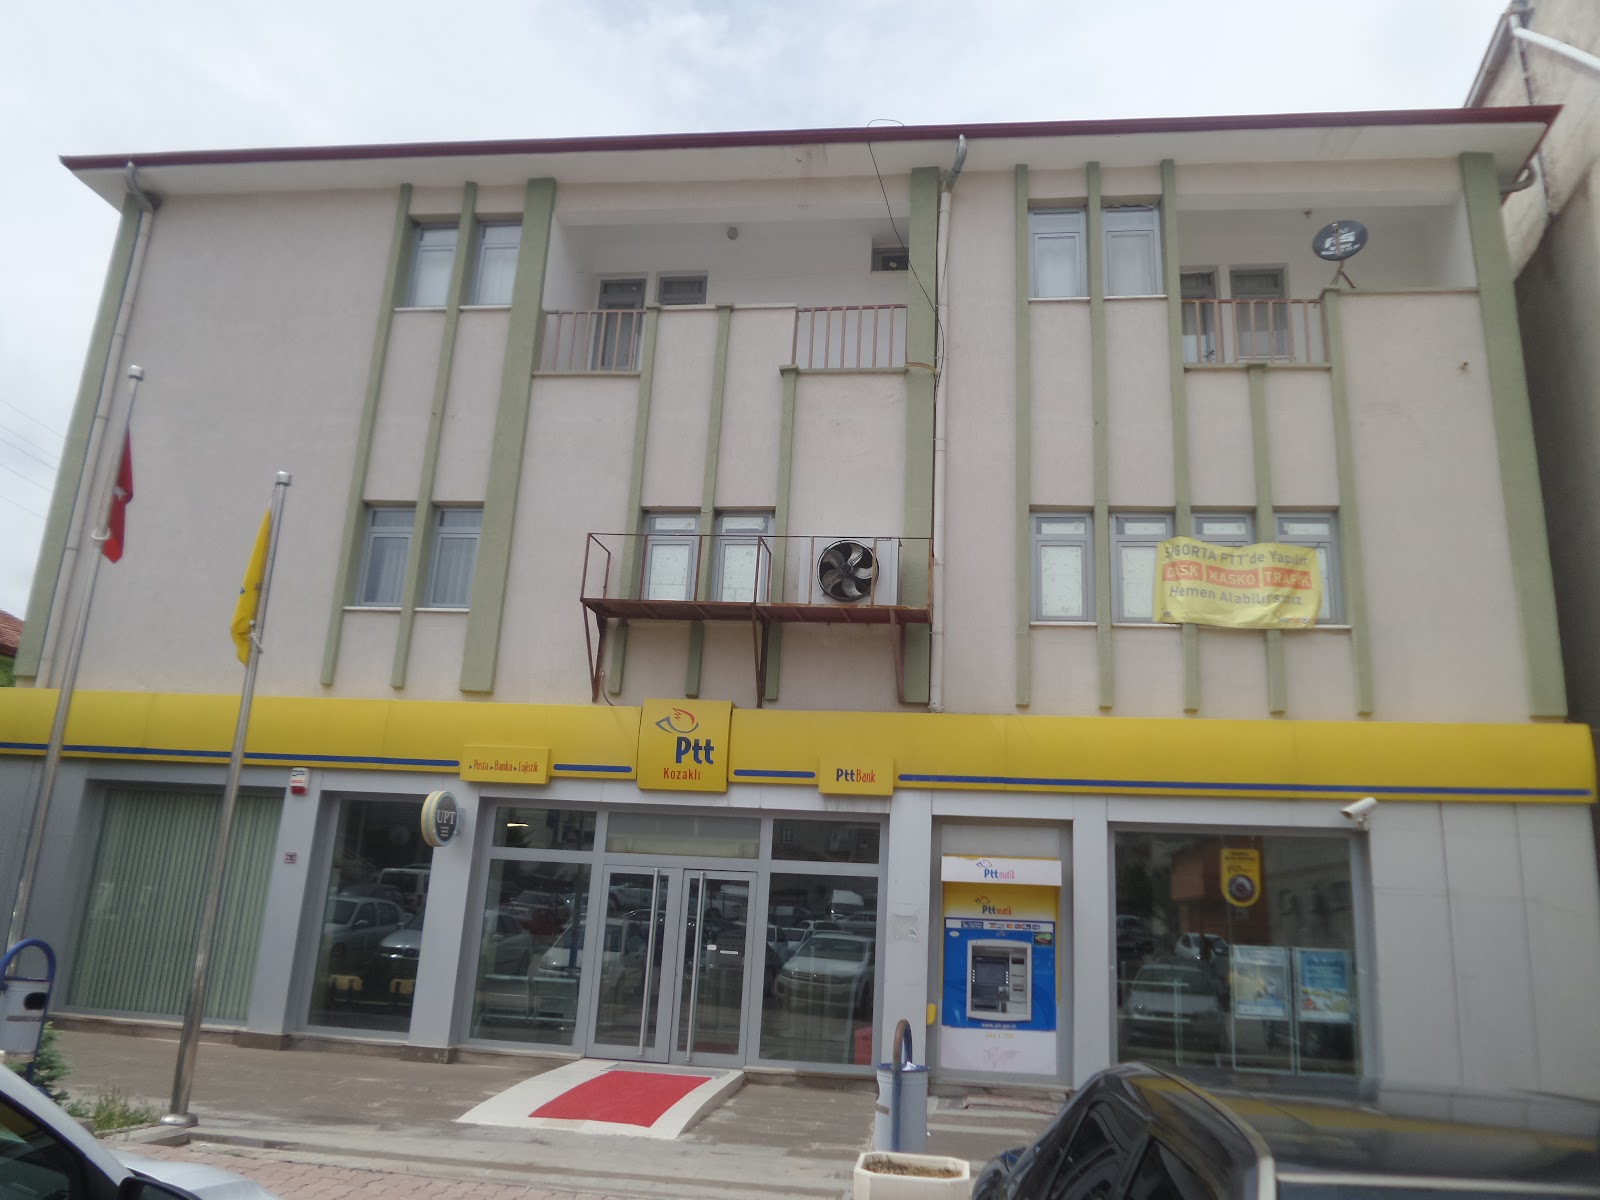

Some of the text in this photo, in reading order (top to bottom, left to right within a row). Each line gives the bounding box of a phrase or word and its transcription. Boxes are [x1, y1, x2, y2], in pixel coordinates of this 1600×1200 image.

[1209, 570, 1256, 586] KASKO
[1169, 586, 1216, 600] Hemen
[675, 736, 715, 765] Ptt
[473, 759, 539, 775] Posta Banka Lojistik
[663, 767, 701, 781] Kozaklı
[437, 810, 456, 825] UPT
